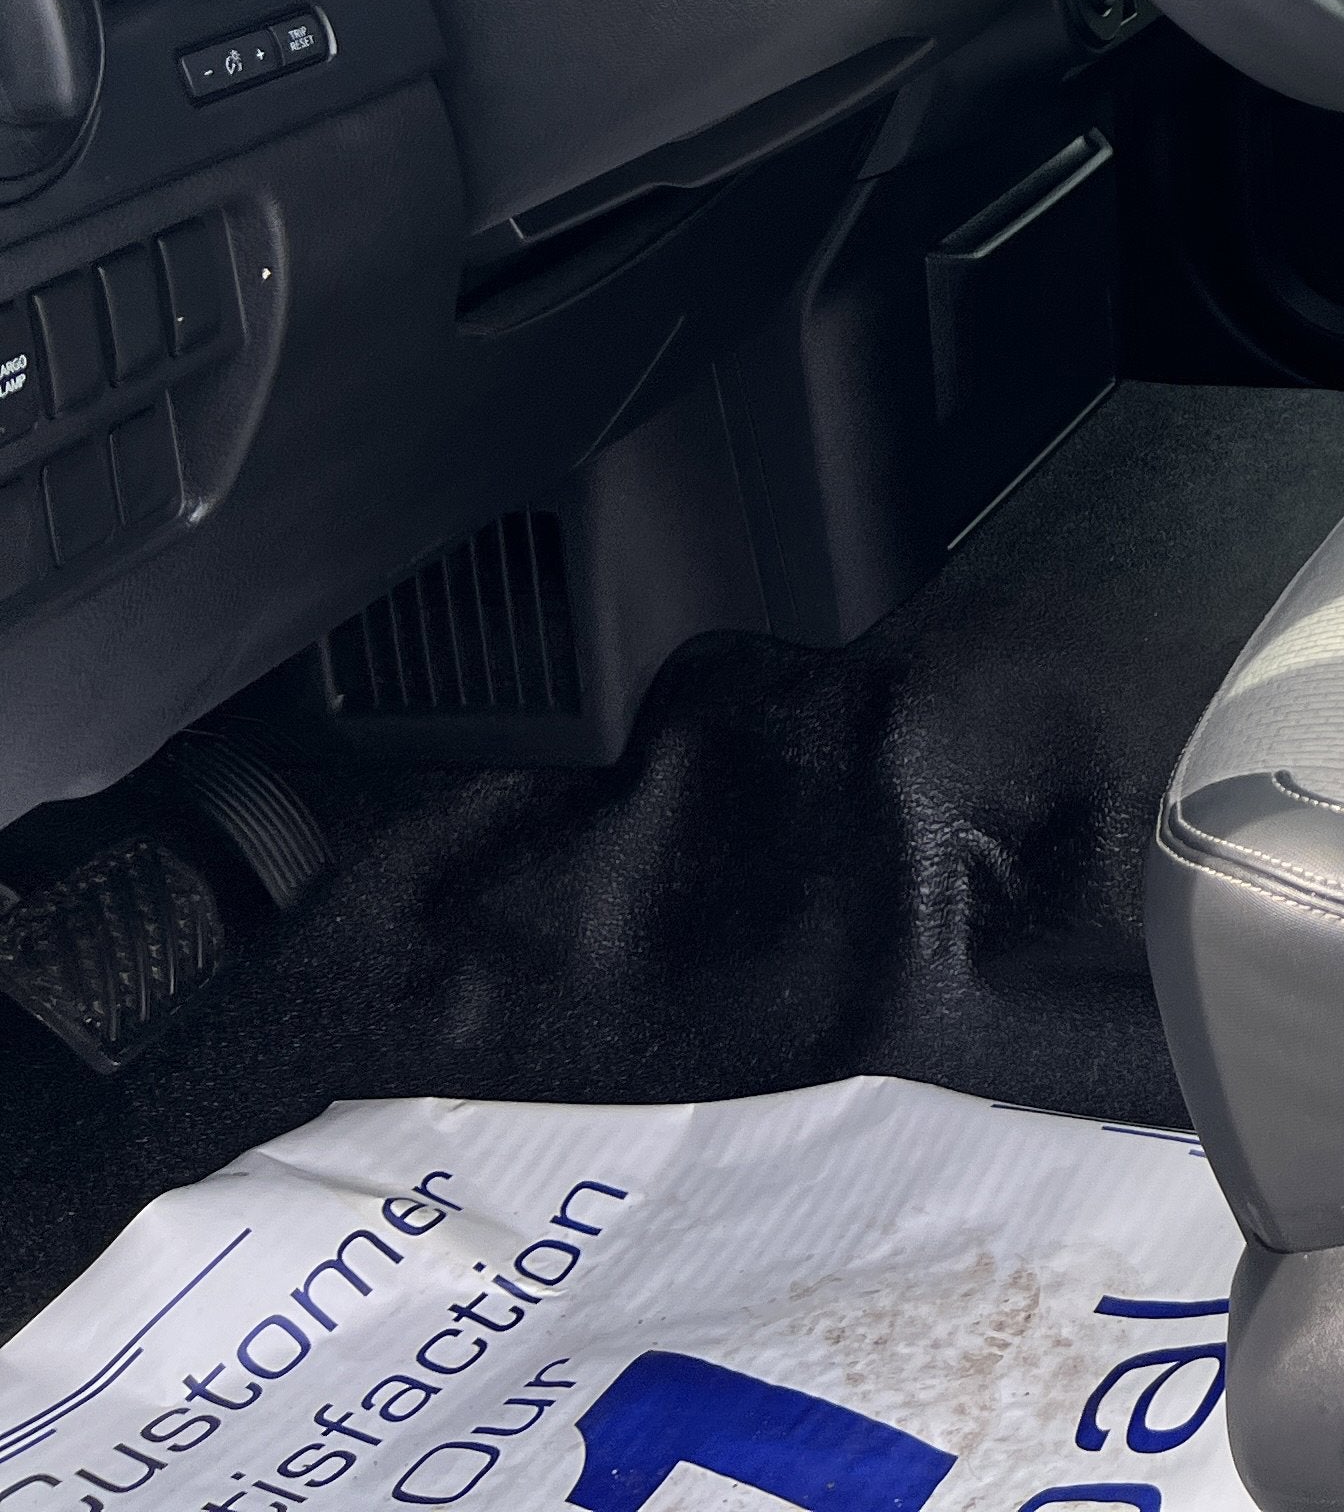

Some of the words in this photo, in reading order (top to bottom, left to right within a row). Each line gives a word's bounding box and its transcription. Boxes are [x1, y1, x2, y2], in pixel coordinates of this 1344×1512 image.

[287, 25, 307, 39] TRIP
[289, 34, 315, 52] RESET
[391, 1357, 577, 1505] Our
